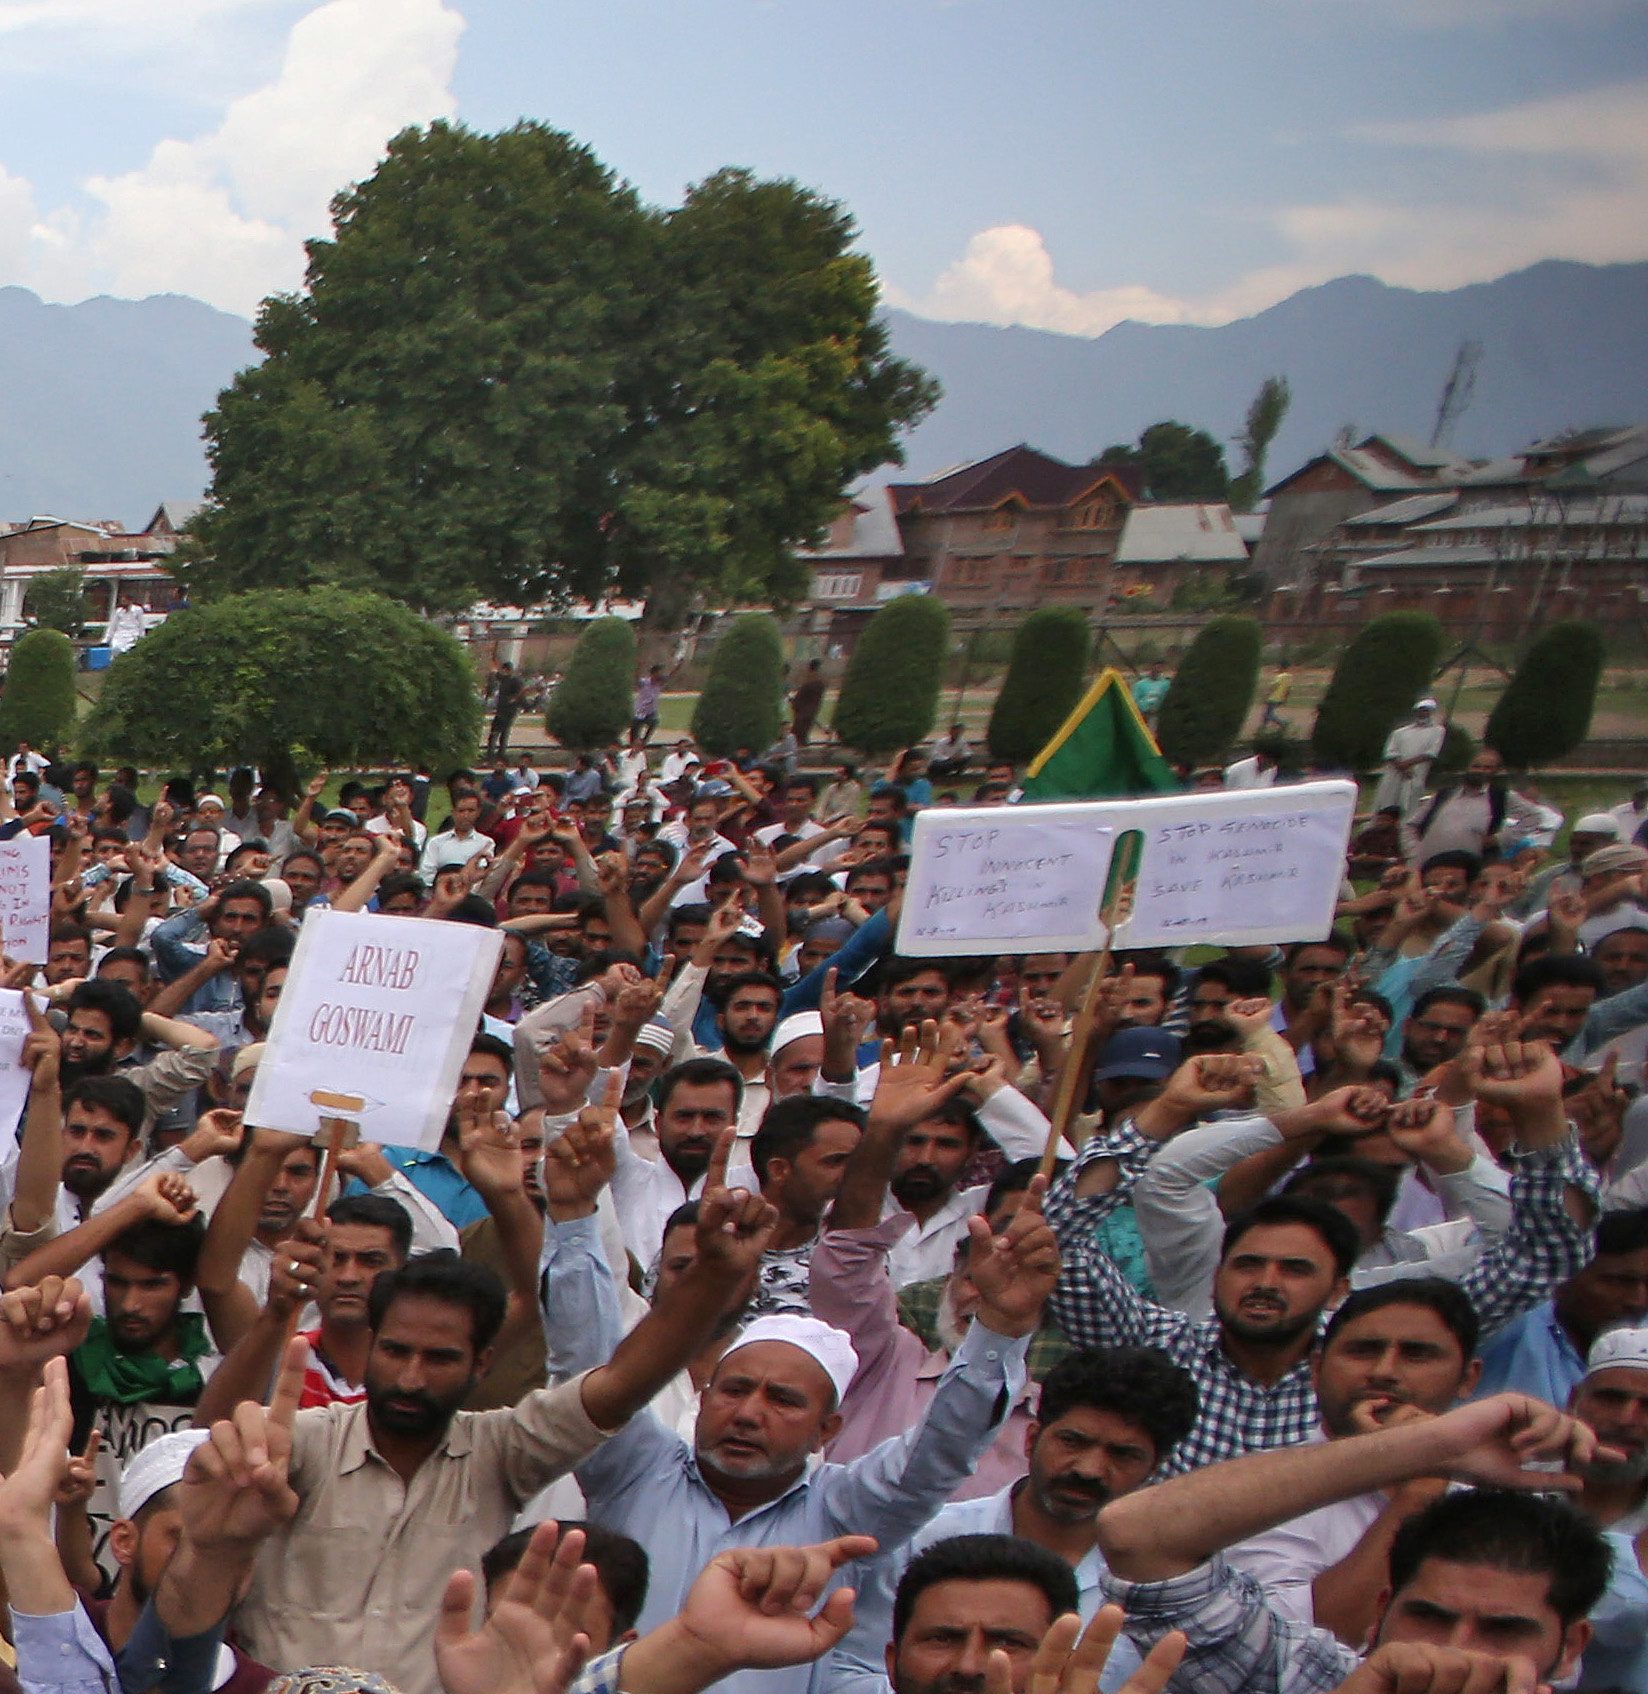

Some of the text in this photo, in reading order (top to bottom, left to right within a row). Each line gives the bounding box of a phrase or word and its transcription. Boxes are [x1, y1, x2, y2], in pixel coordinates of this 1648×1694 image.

[934, 829, 1000, 858] STOP
[1157, 824, 1212, 844] STOP
[338, 944, 419, 990] ARNAB
[309, 1003, 416, 1055] GOSWAMI
